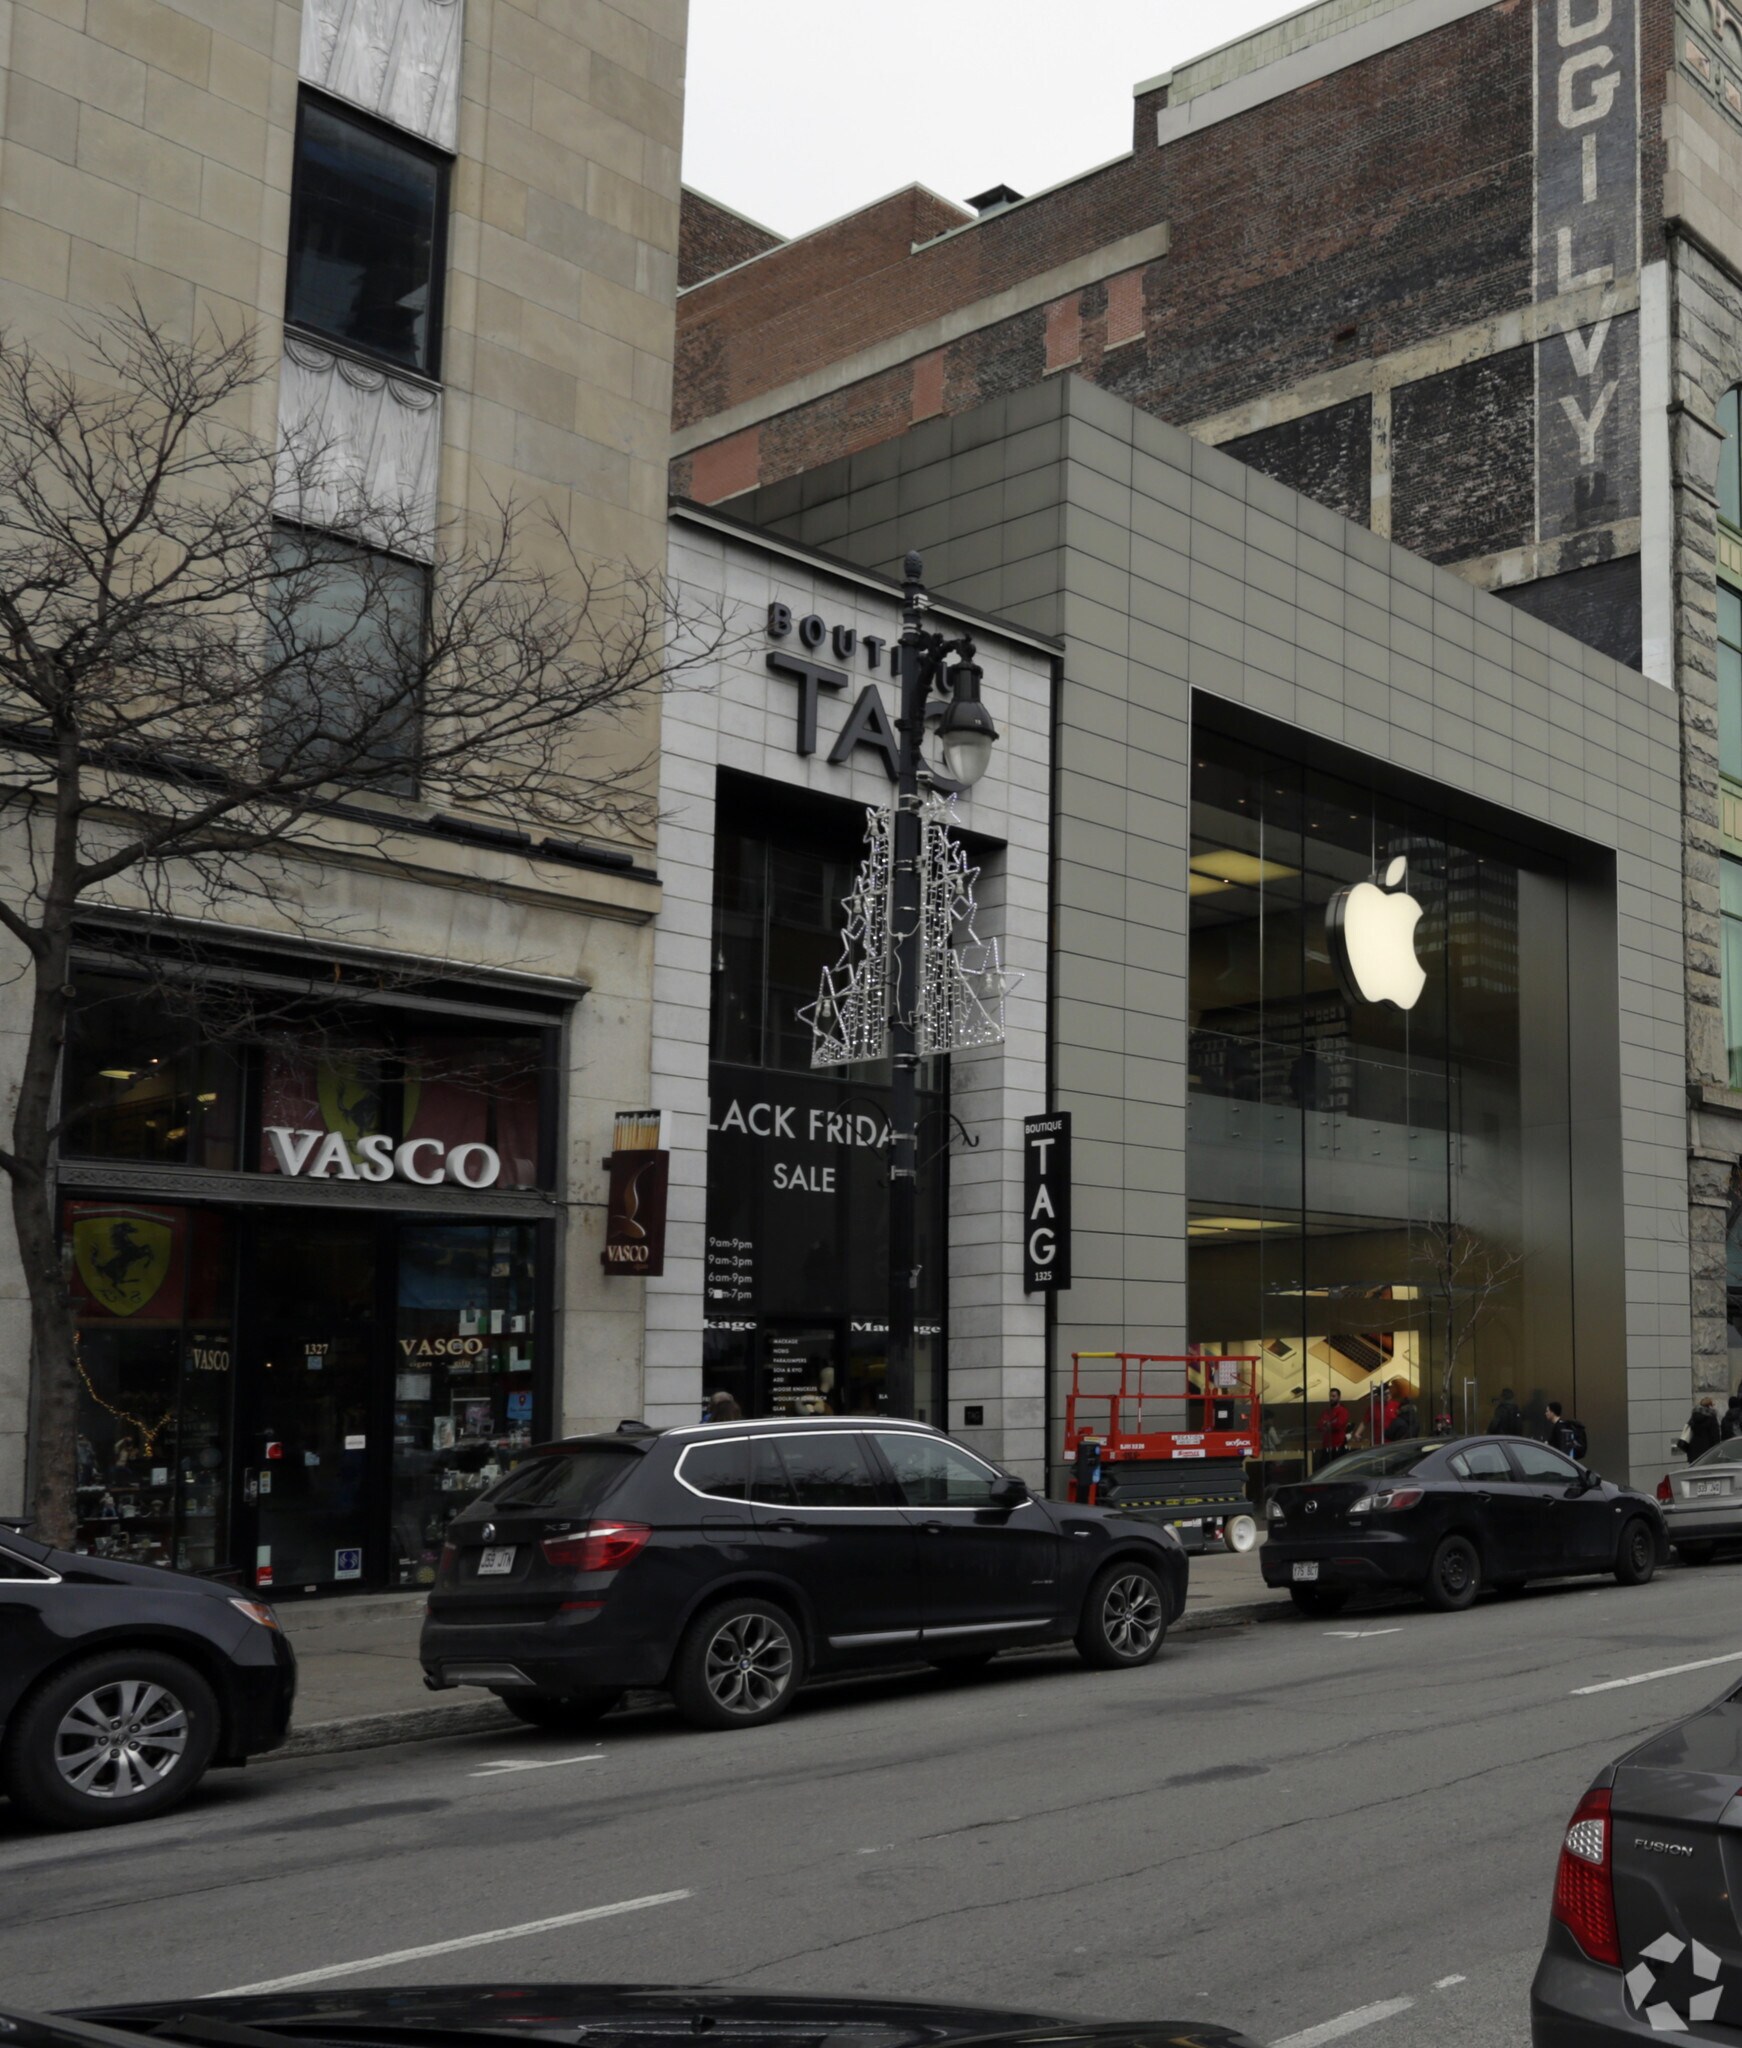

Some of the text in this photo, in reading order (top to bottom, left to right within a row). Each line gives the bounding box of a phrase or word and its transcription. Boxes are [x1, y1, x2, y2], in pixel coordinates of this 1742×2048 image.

[768, 602, 956, 693] BOUTIU
[707, 1096, 892, 1149] LACK FRIDA
[1025, 1119, 1062, 1134] BOUTIQUE
[263, 1126, 500, 1189] VASCO
[772, 1163, 835, 1193] SALE
[1029, 1138, 1057, 1265] TAG
[708, 1236, 753, 1251] 9am-9pm
[607, 1245, 649, 1263] VASCO
[707, 1254, 753, 1268] 9am-3pm
[707, 1272, 753, 1286] 6am-9pm
[1034, 1271, 1053, 1282] 1325
[707, 1287, 752, 1302] 9m-7pm
[703, 1318, 758, 1332] kage
[850, 1321, 942, 1336] Mage
[304, 1343, 329, 1355] 1327
[399, 1338, 483, 1356] VASCO
[193, 1348, 230, 1371] VASCO
[544, 1523, 571, 1532] X3
[1634, 1838, 1694, 1858] FUSION
